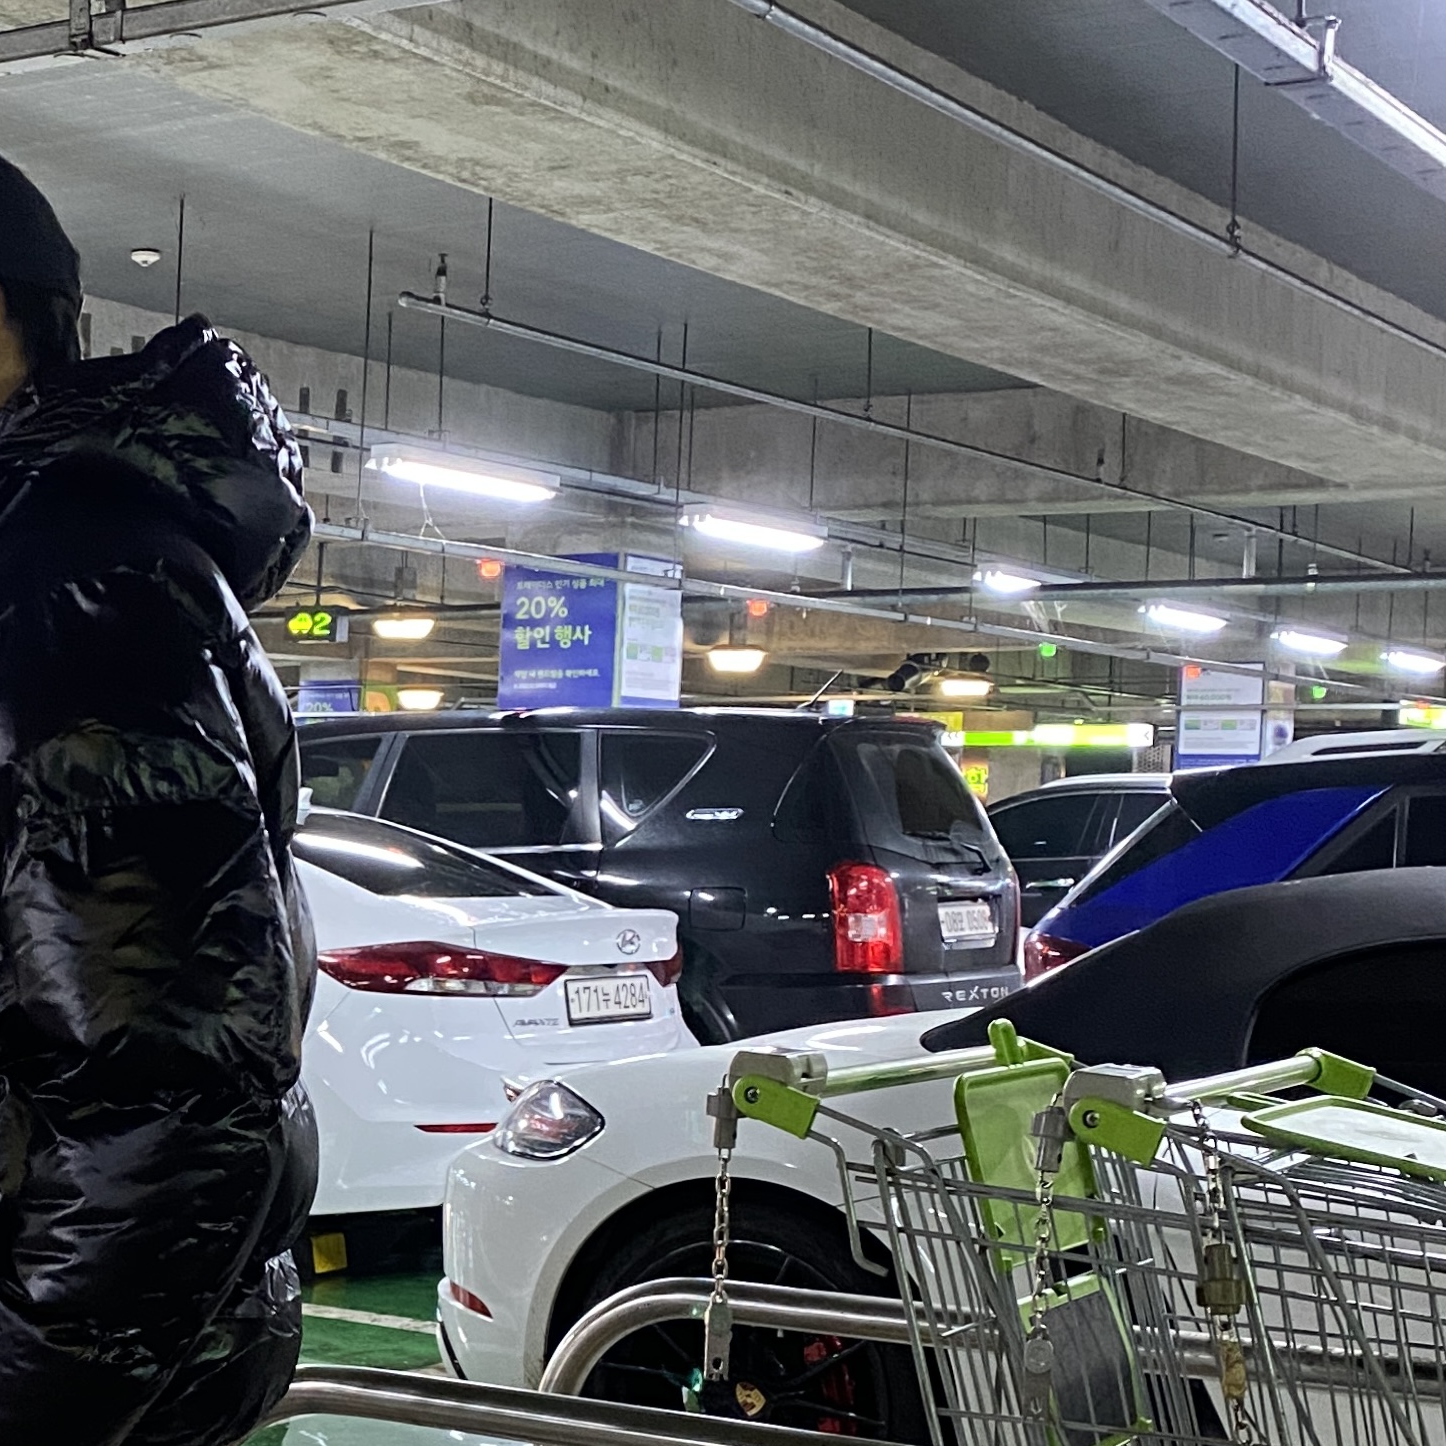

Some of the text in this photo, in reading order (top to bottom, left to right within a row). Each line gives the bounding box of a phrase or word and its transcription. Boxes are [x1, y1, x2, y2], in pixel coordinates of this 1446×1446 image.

[515, 596, 568, 619] 20%
[313, 612, 332, 635] 2
[515, 624, 592, 650] 할인 행사
[941, 986, 1009, 1002] REXTON
